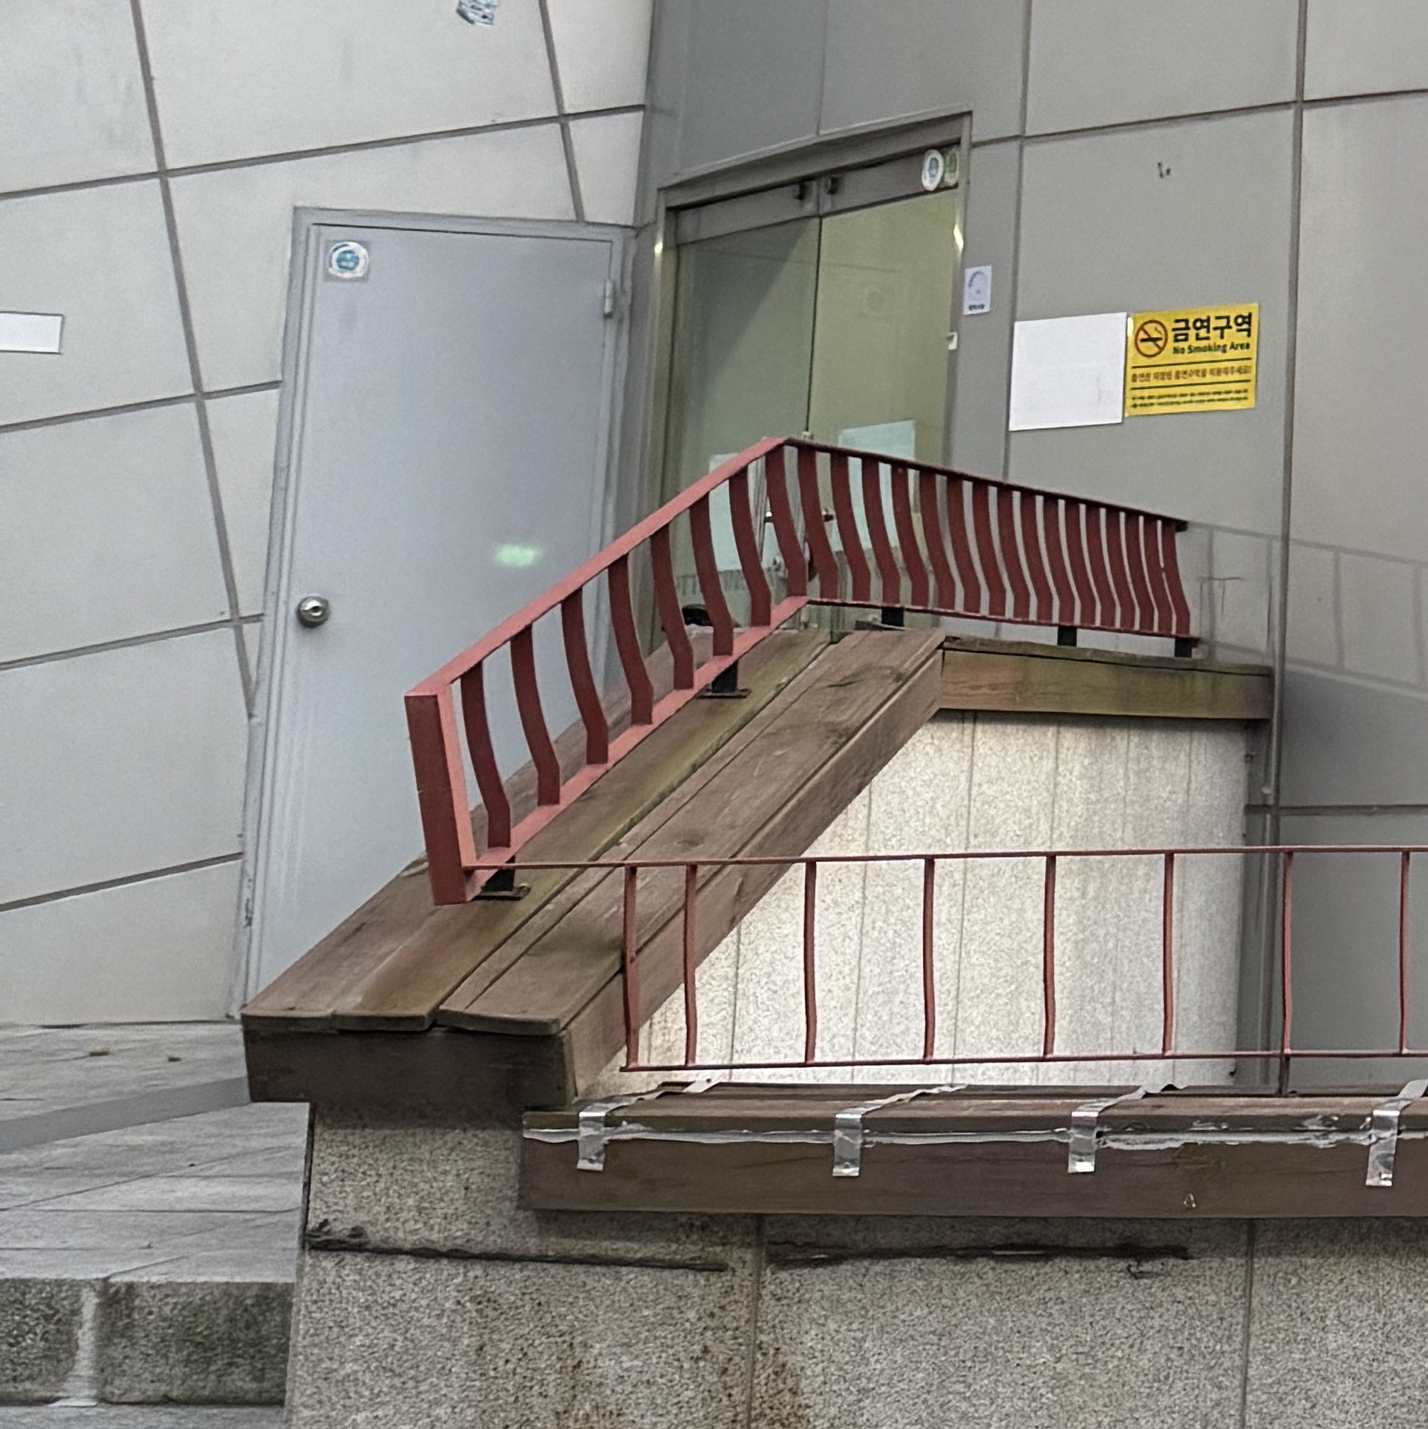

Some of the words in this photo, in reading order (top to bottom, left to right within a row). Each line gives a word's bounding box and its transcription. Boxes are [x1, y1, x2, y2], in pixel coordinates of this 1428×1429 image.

[1171, 312, 1252, 343] 금연구역
[1172, 346, 1186, 355] No
[1187, 342, 1228, 354] Smoking
[1229, 341, 1251, 351] Area
